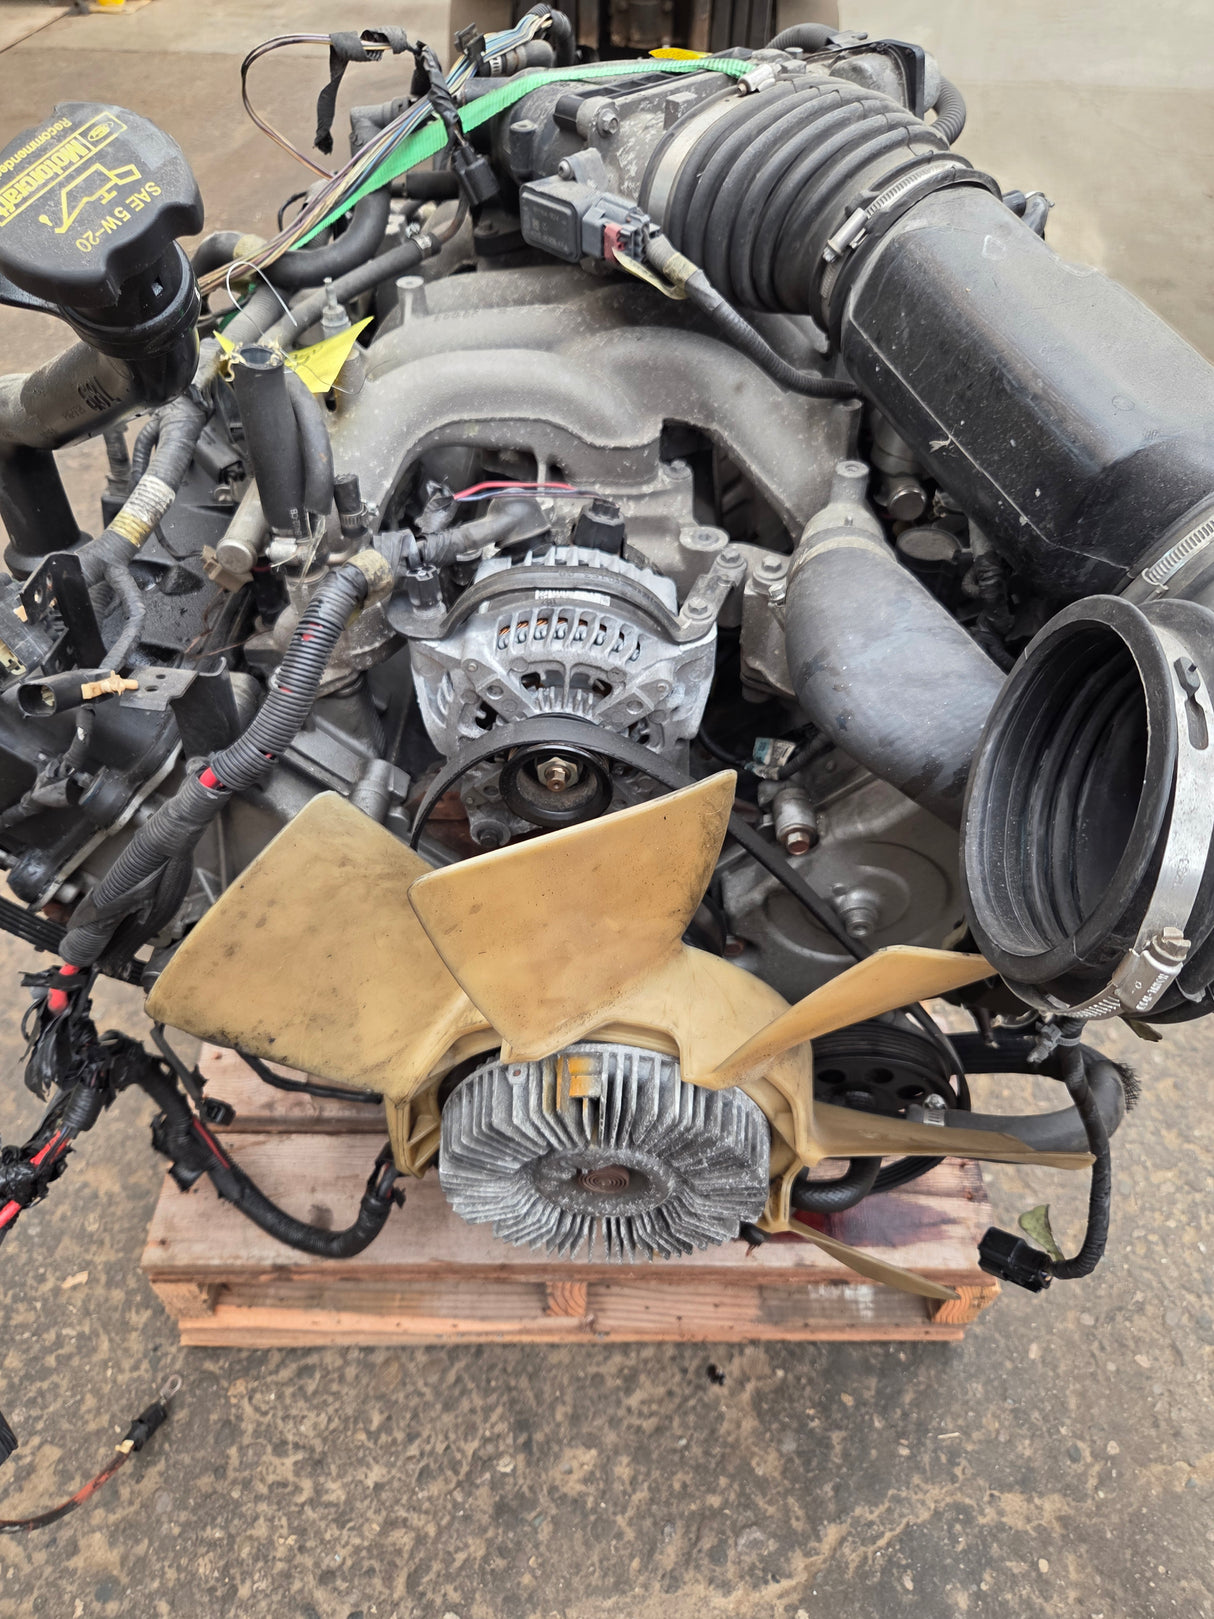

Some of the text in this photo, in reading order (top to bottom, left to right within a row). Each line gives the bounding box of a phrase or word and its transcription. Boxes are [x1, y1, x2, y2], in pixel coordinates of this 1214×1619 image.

[0, 117, 73, 179] Recommende
[75, 181, 162, 252] SAE 5W-20
